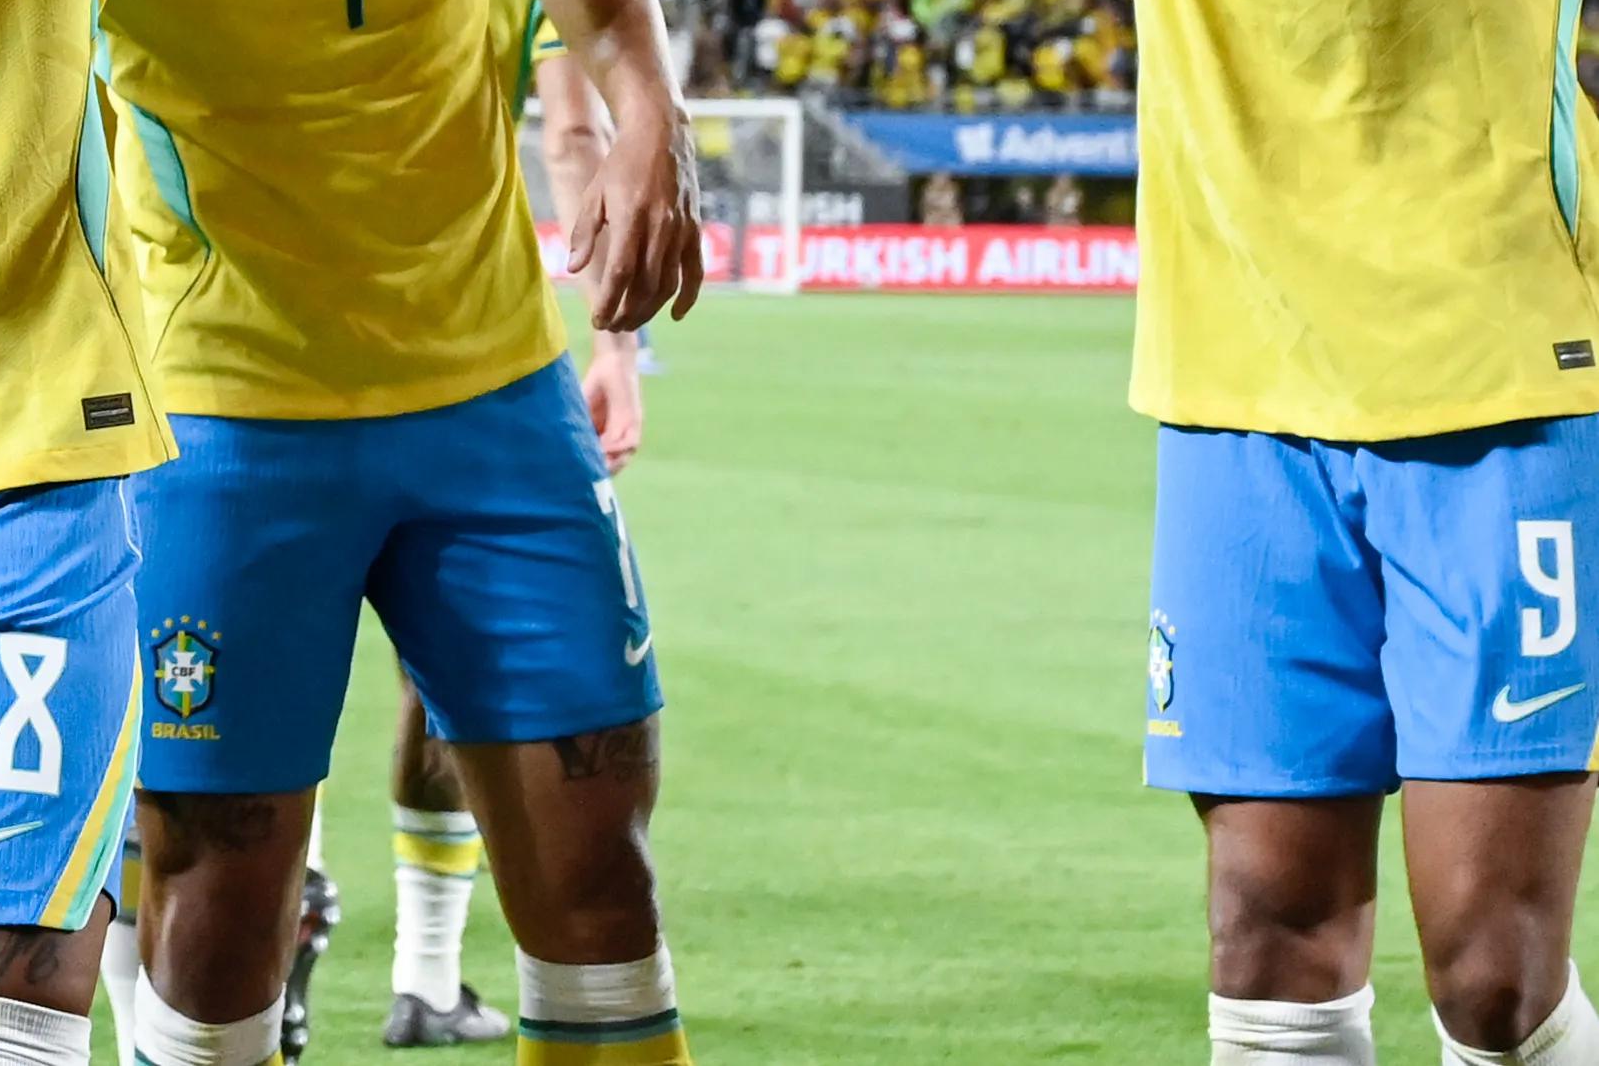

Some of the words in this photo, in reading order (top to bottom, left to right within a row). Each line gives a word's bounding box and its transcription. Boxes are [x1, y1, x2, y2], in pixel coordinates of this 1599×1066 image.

[999, 123, 1139, 164] Advent
[1515, 520, 1578, 658] 9
[171, 665, 197, 678] CBF
[152, 721, 221, 740] BRASIL
